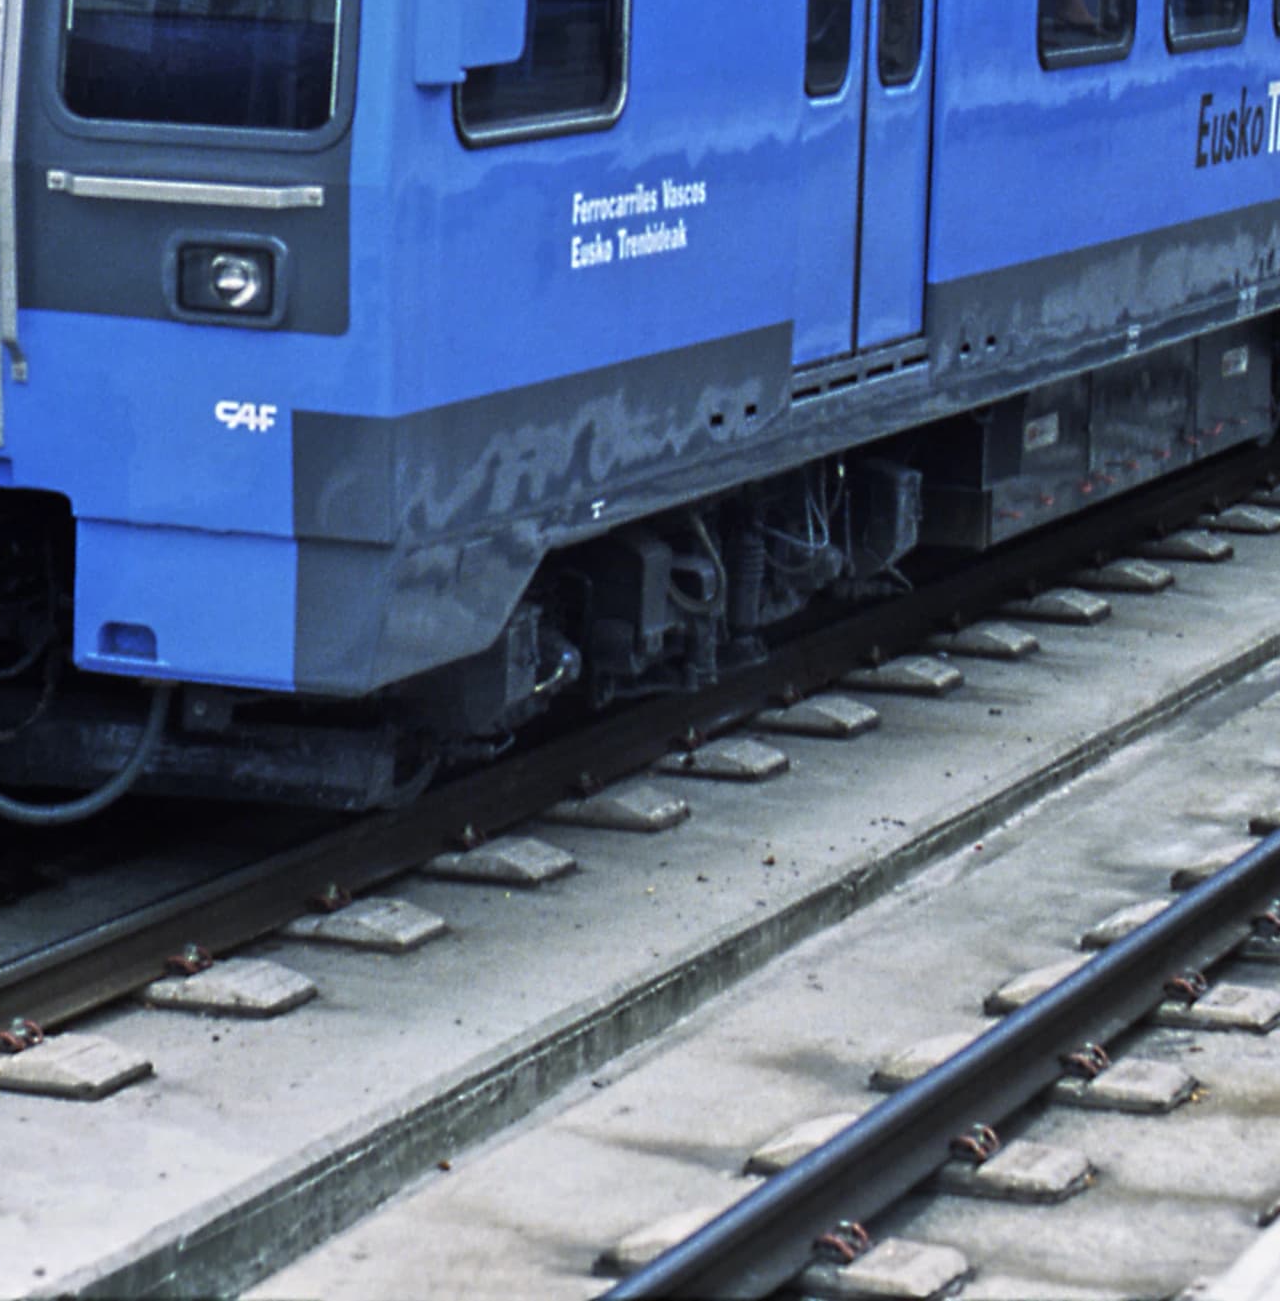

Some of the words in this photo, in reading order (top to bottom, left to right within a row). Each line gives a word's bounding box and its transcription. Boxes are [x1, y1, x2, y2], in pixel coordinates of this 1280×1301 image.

[572, 183, 658, 225] Ferrocarriles
[662, 178, 707, 209] Vascos
[571, 234, 613, 268] Eusko
[617, 218, 688, 260] Trenbideak
[215, 400, 278, 432] CAF
